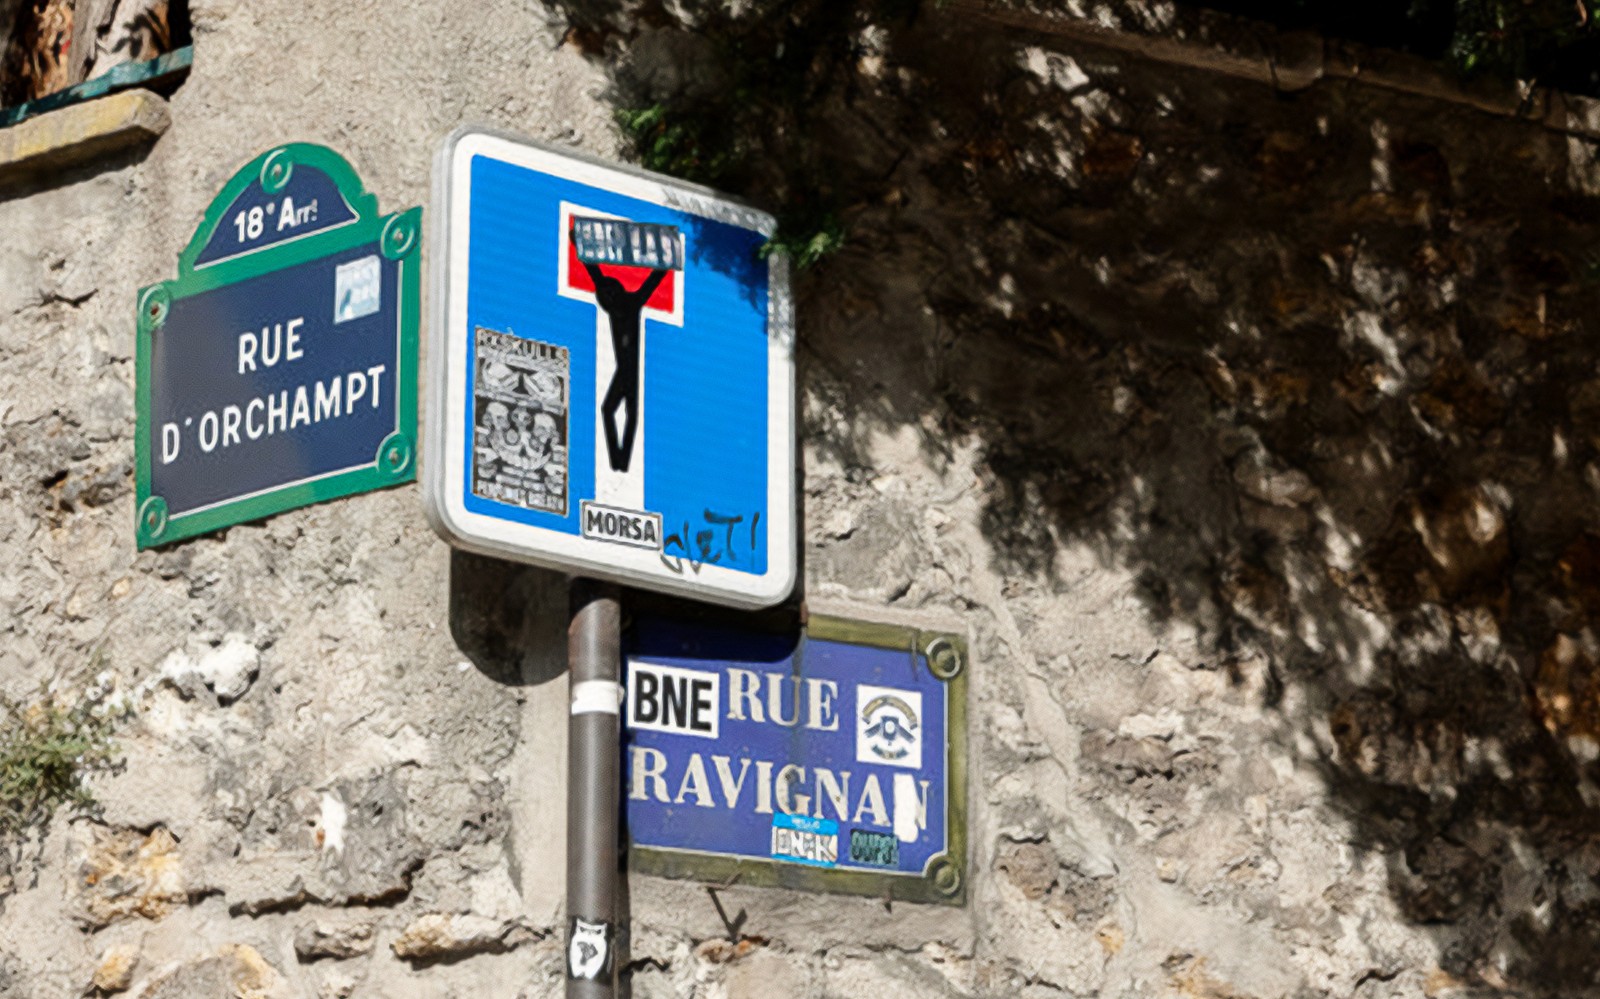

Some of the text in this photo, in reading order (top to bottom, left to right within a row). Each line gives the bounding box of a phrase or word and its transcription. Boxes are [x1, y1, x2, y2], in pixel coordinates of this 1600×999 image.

[238, 316, 304, 374] RUE
[162, 364, 385, 464] D'ORCHAMPT
[587, 509, 656, 543] MORSA
[634, 671, 712, 732] BNE
[727, 667, 839, 732] RUE
